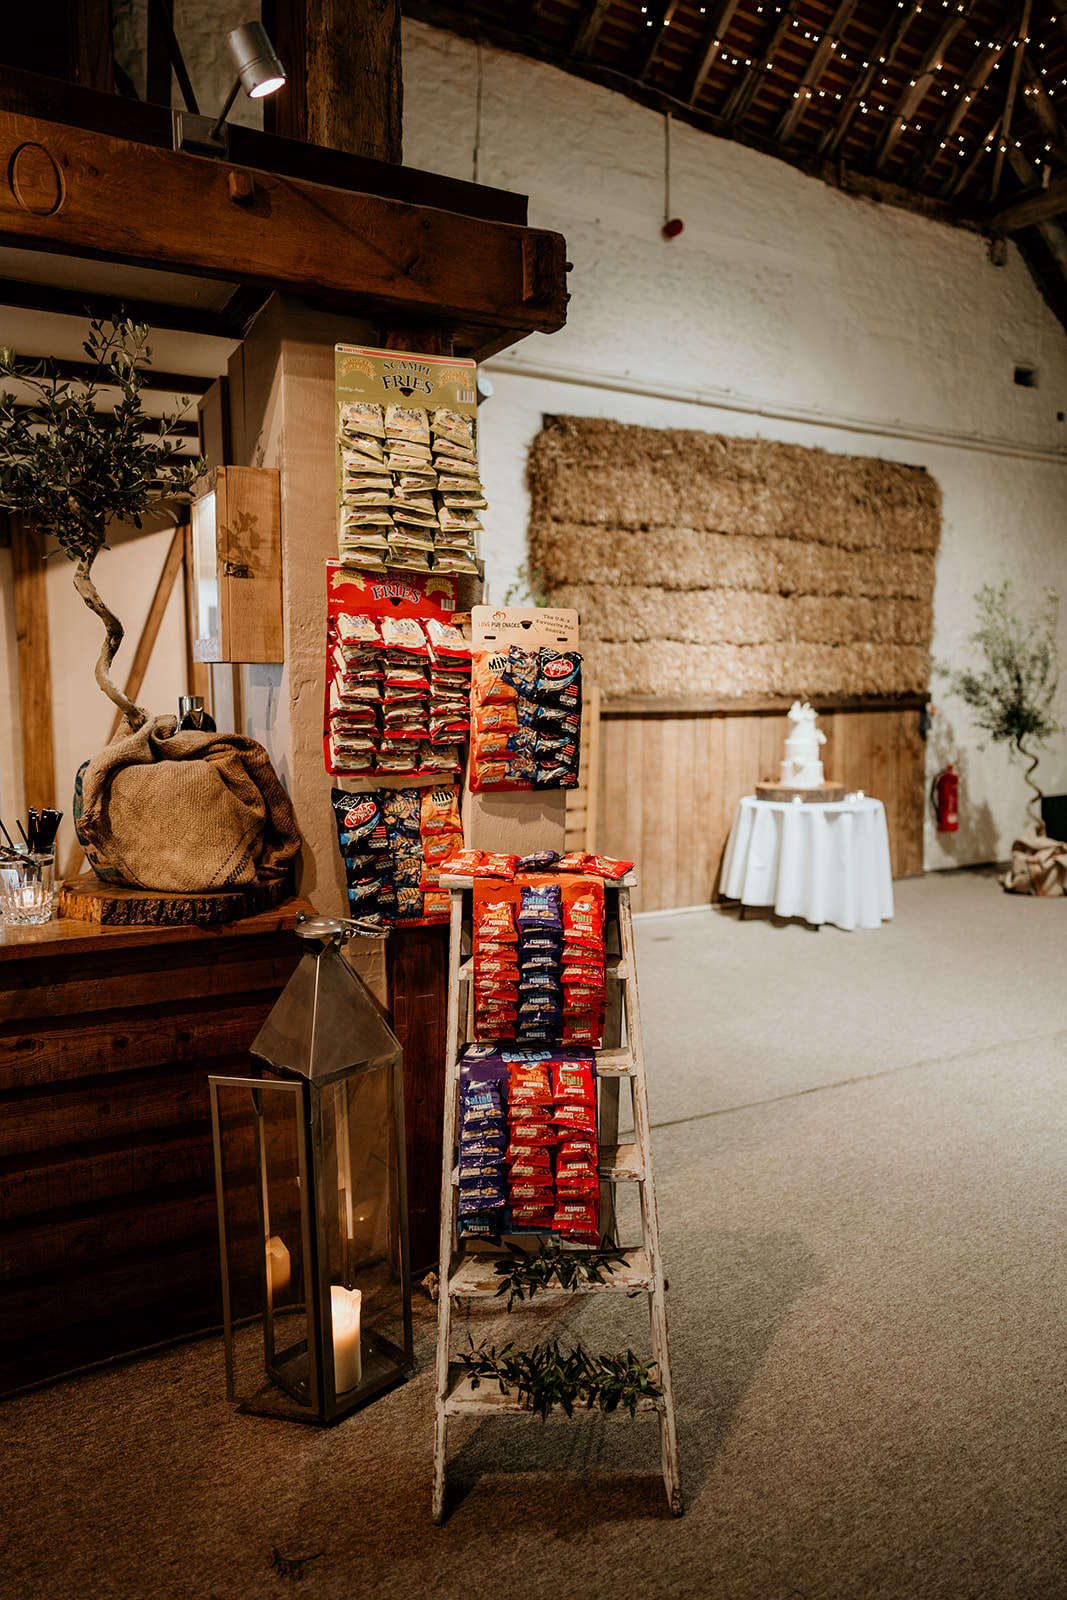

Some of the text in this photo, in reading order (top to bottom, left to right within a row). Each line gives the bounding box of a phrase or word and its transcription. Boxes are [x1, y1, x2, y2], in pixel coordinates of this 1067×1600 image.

[384, 361, 431, 376] SCAMPI
[381, 375, 434, 394] FRIES
[371, 584, 421, 604] FRIES
